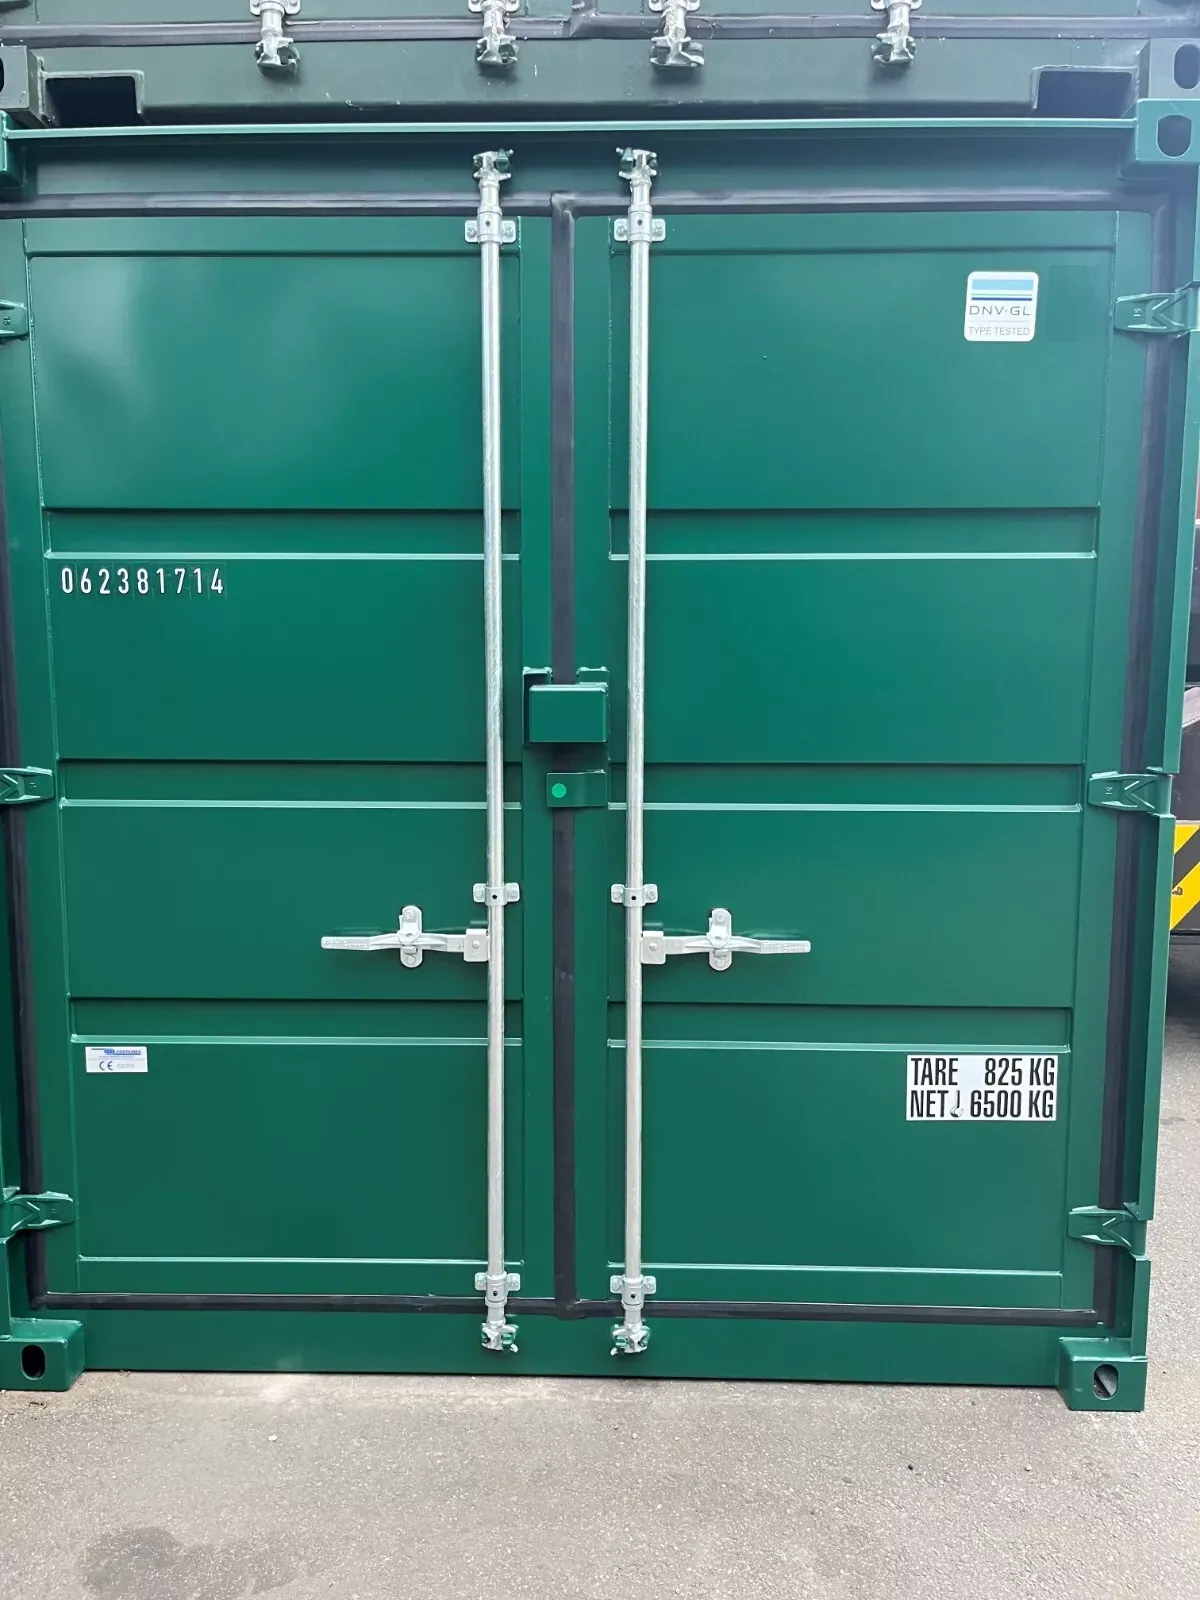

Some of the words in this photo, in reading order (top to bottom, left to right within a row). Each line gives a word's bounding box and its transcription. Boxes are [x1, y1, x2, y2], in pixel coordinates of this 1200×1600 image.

[968, 326, 992, 335] TYPE
[994, 327, 1030, 336] TESTED
[61, 567, 224, 594] 062381714
[910, 1057, 959, 1086] TARE
[984, 1057, 1023, 1087] 825
[1029, 1057, 1056, 1087] KG
[910, 1089, 949, 1118] NET
[970, 1089, 1022, 1118] 6500
[1028, 1089, 1055, 1119] KG
